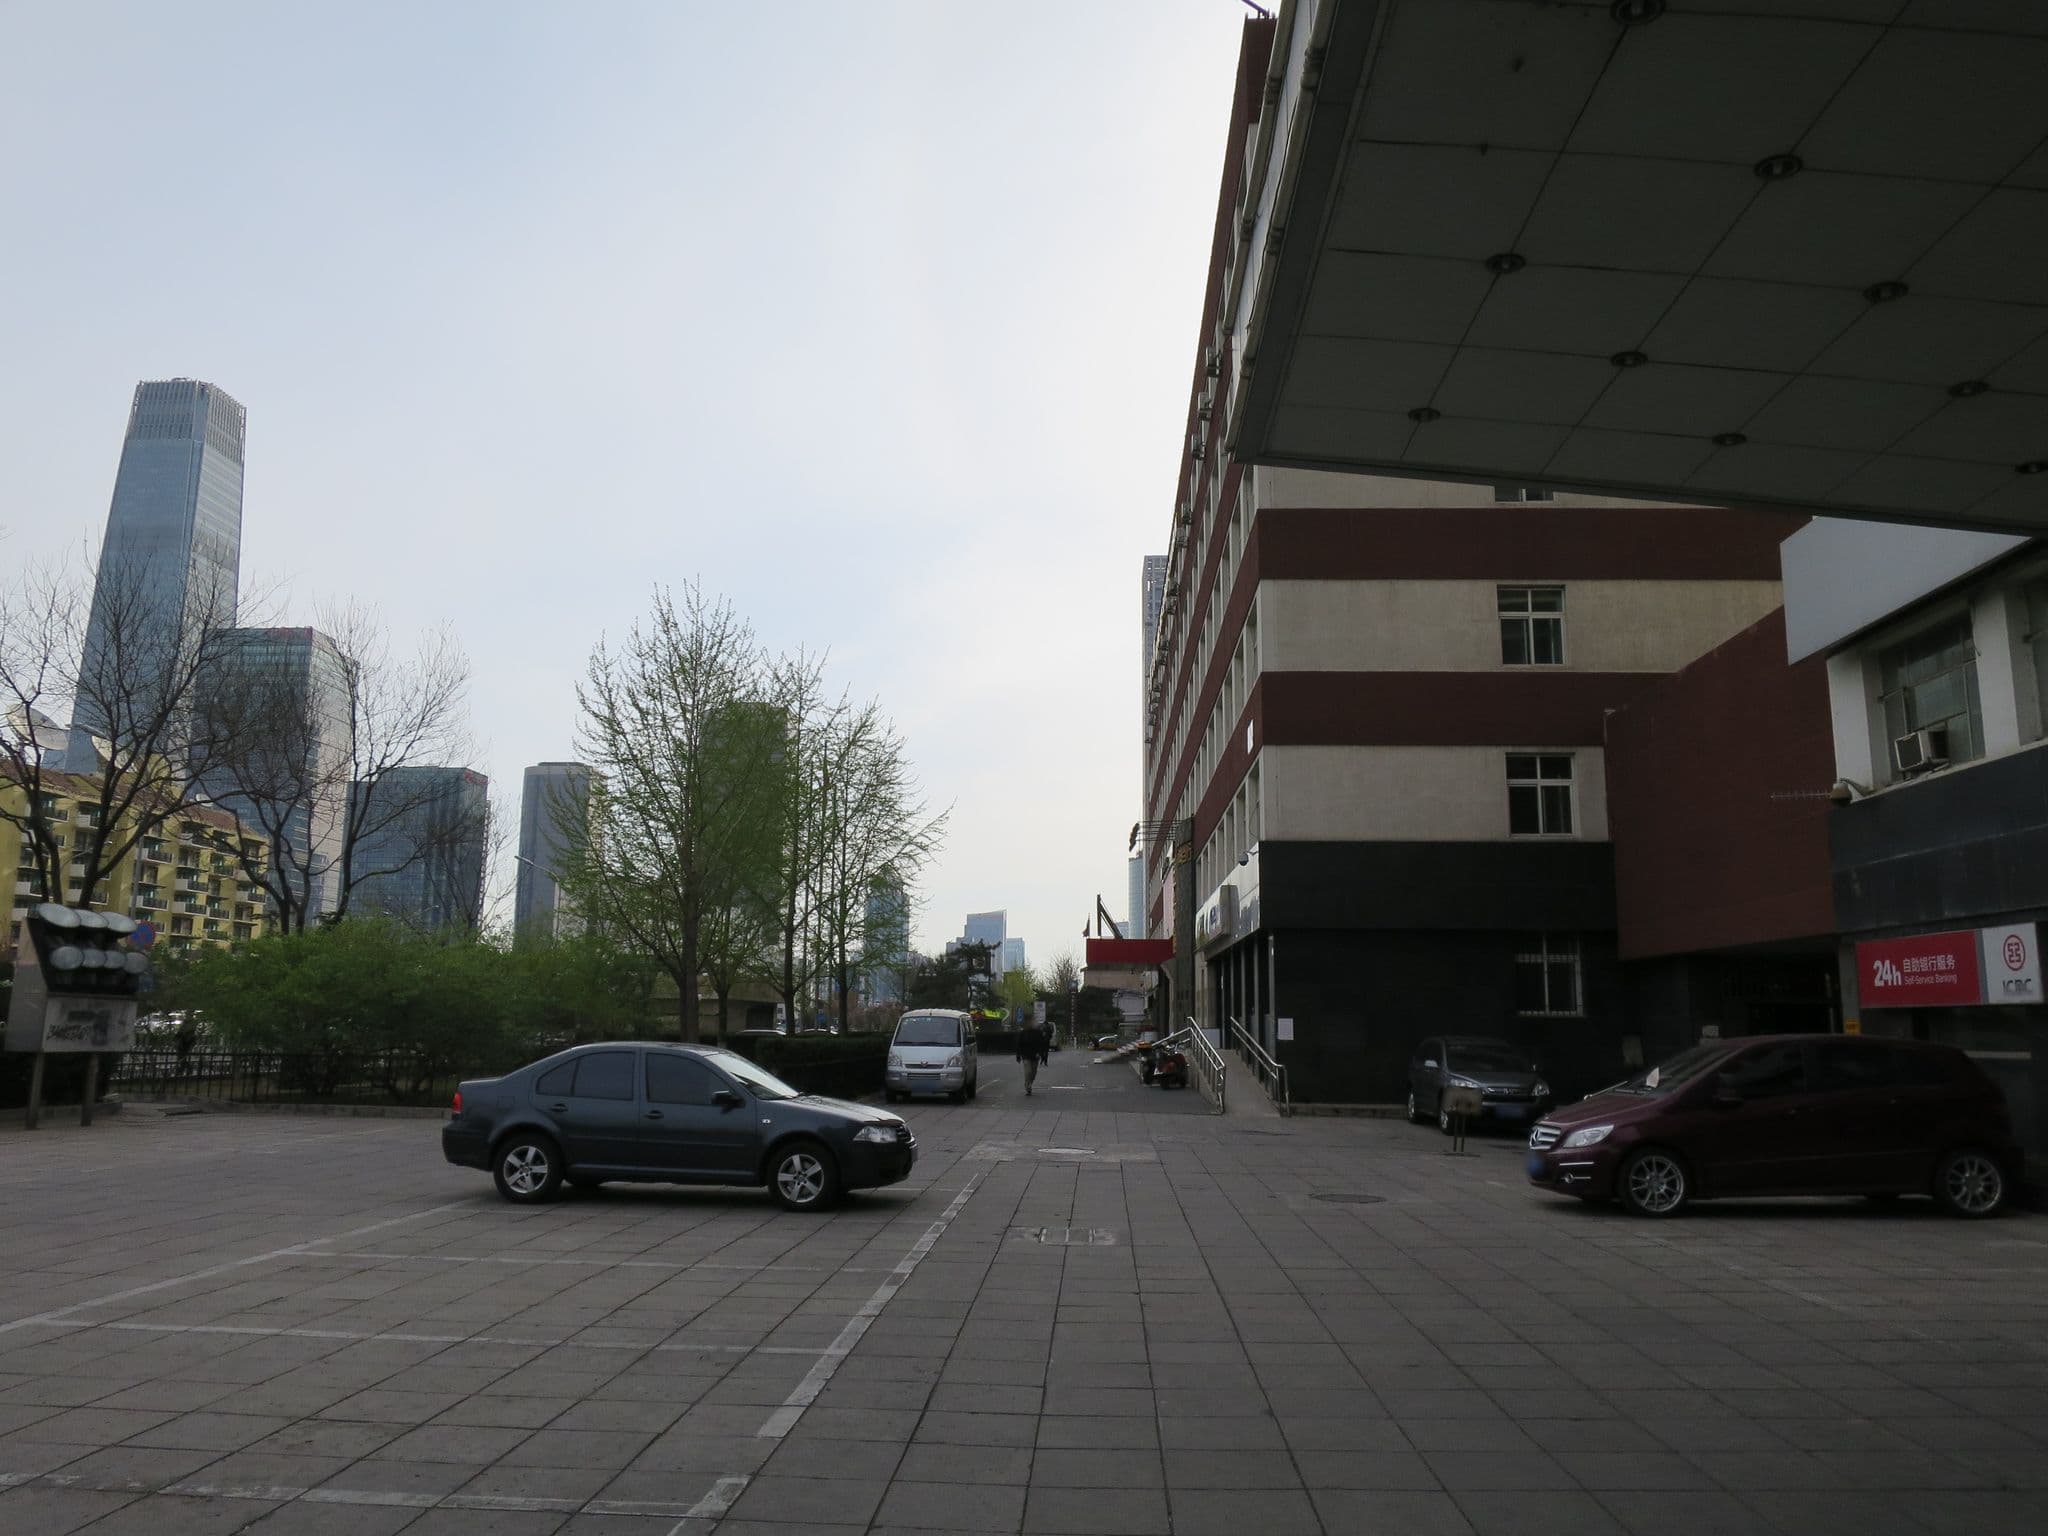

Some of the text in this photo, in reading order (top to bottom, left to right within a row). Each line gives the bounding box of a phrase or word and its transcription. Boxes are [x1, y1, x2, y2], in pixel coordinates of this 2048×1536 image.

[1873, 959, 1902, 987] 24h
[1903, 954, 1956, 973] 自助银行服务
[1904, 974, 1958, 985] Self-Service Banking
